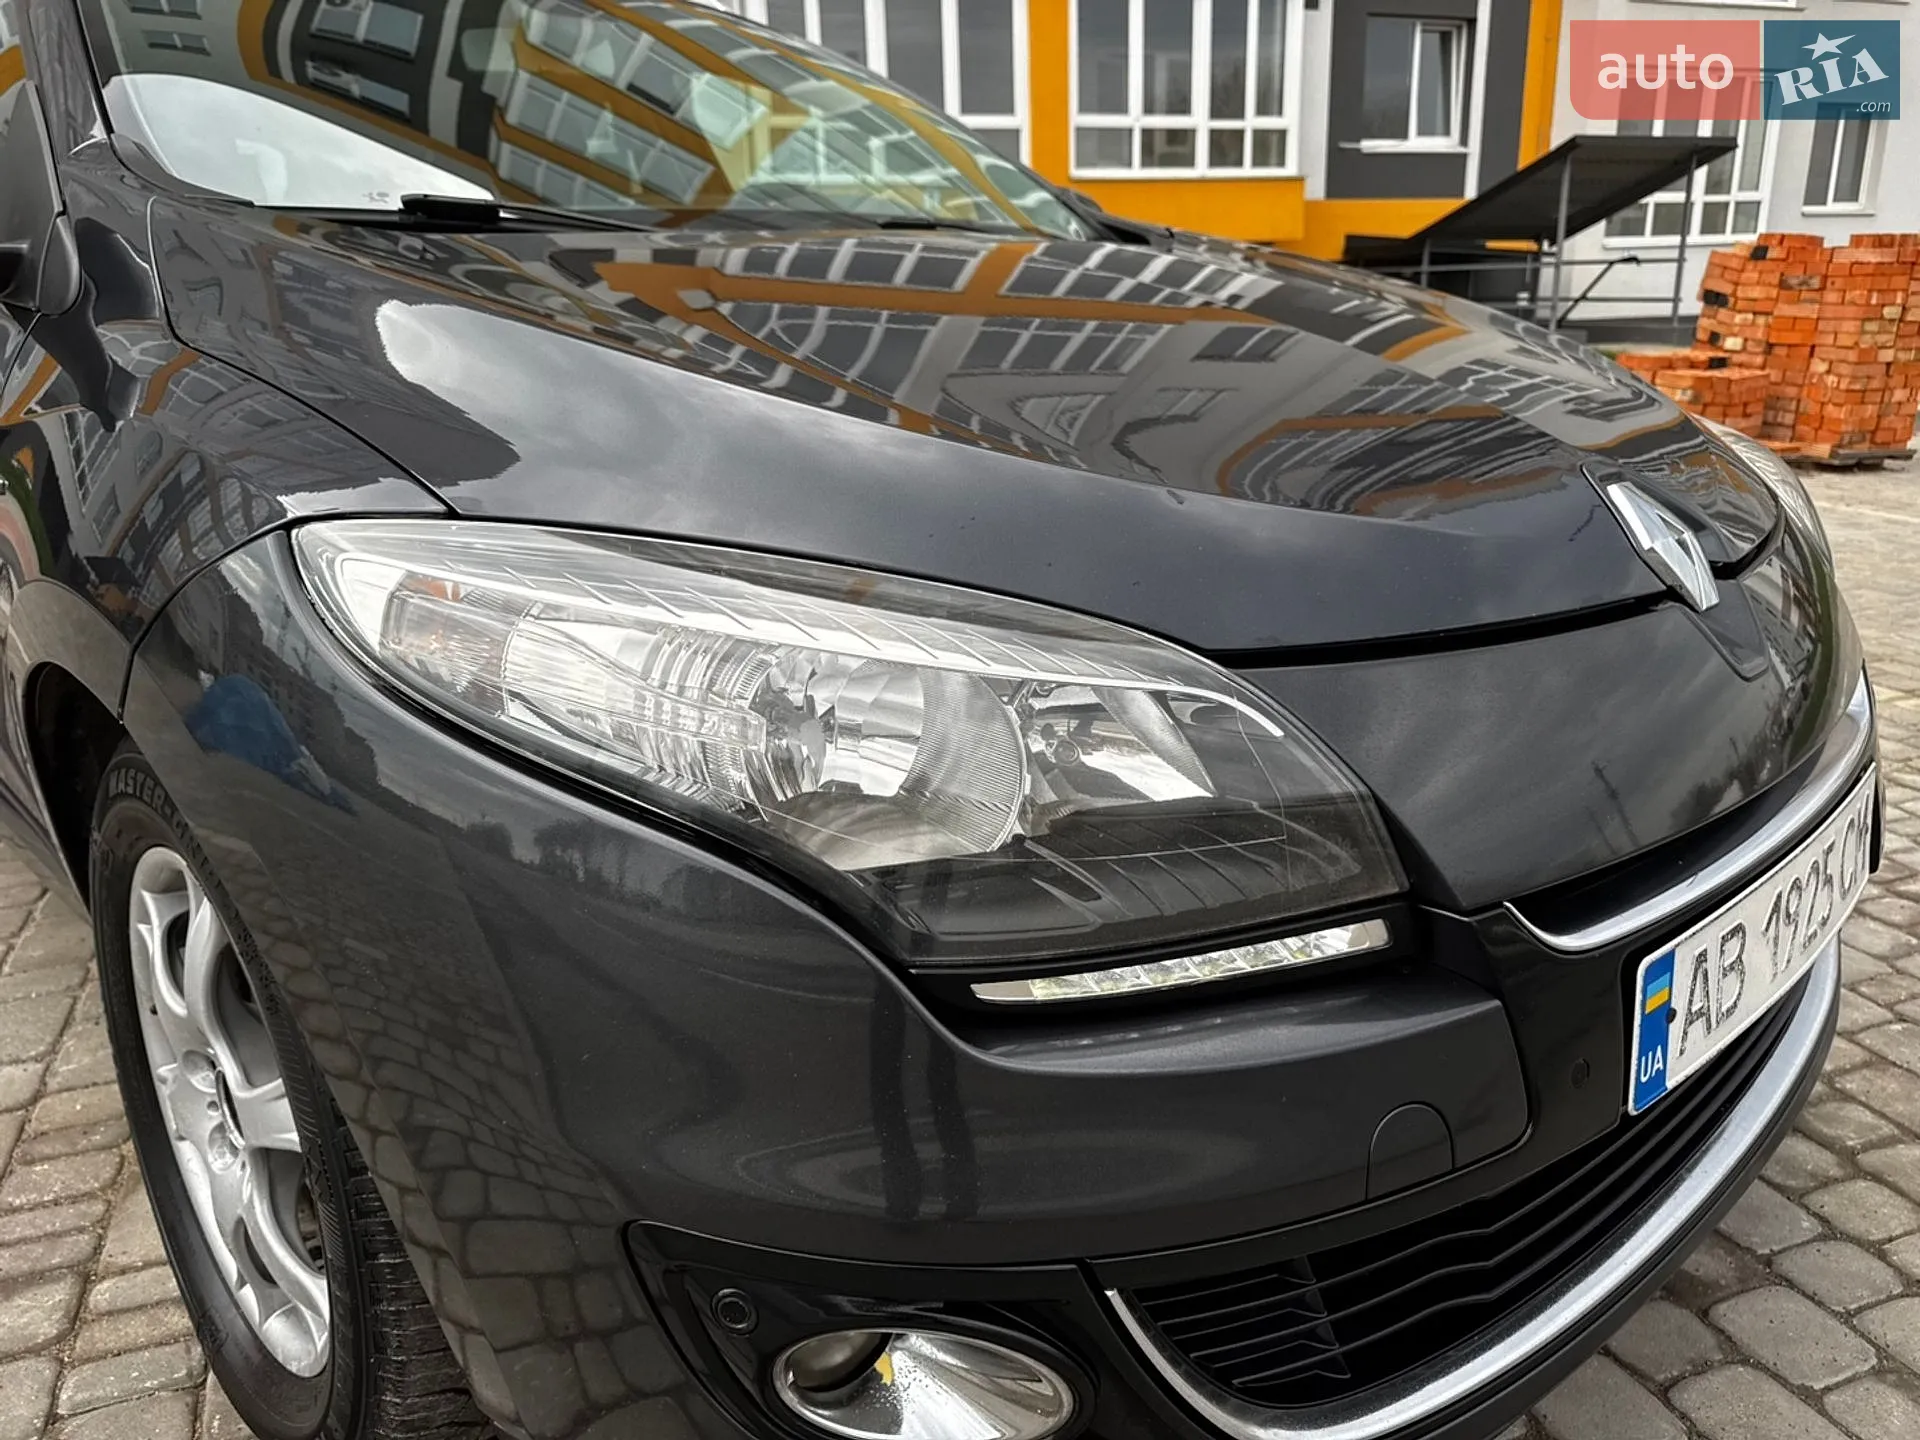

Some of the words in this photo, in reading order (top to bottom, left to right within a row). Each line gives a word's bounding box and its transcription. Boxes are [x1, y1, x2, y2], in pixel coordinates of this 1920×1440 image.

[1677, 919, 1747, 1058] AB
[1761, 836, 1837, 984] 1925
[1639, 1044, 1664, 1084] UA
